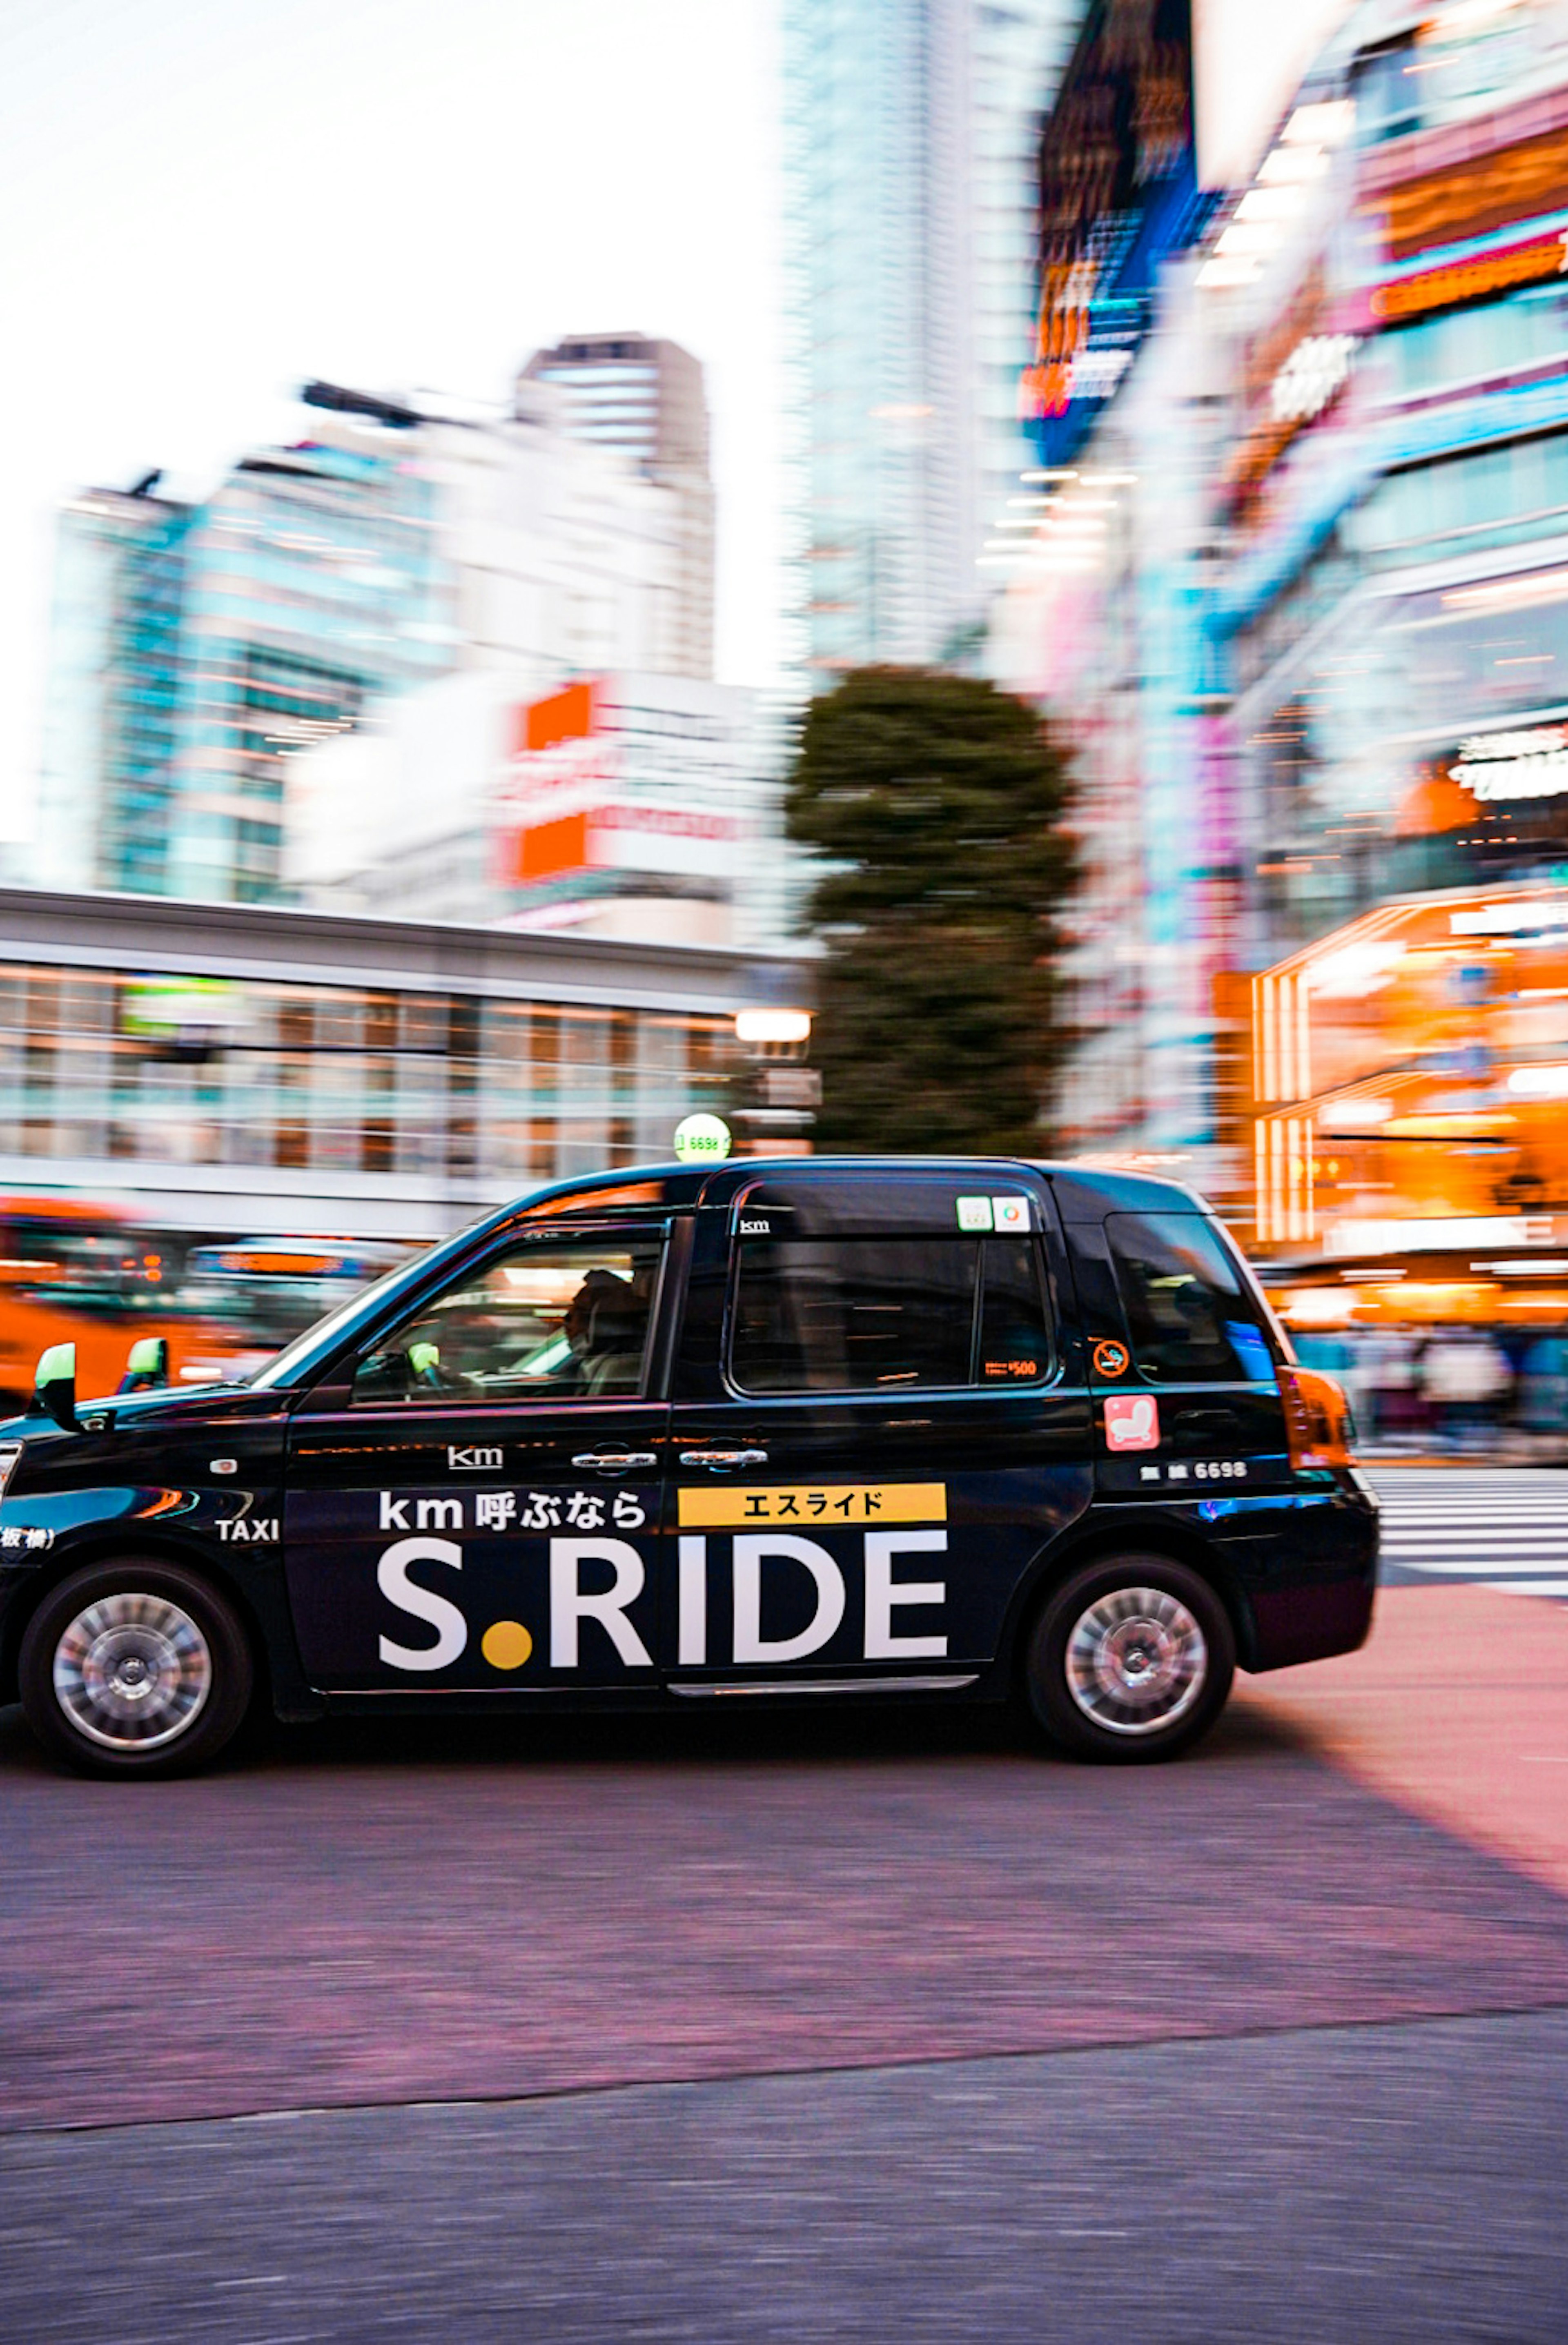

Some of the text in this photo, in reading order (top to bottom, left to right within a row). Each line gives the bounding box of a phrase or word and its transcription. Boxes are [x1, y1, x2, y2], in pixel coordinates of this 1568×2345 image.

[740, 1220, 770, 1231] km
[448, 1446, 503, 1466] km
[1195, 1462, 1247, 1479] 6698
[379, 1491, 646, 1531] km 呼ぶなら
[744, 1493, 882, 1516] エスライド
[215, 1519, 278, 1541] TAXI
[377, 1530, 948, 1670] S.RIDE
